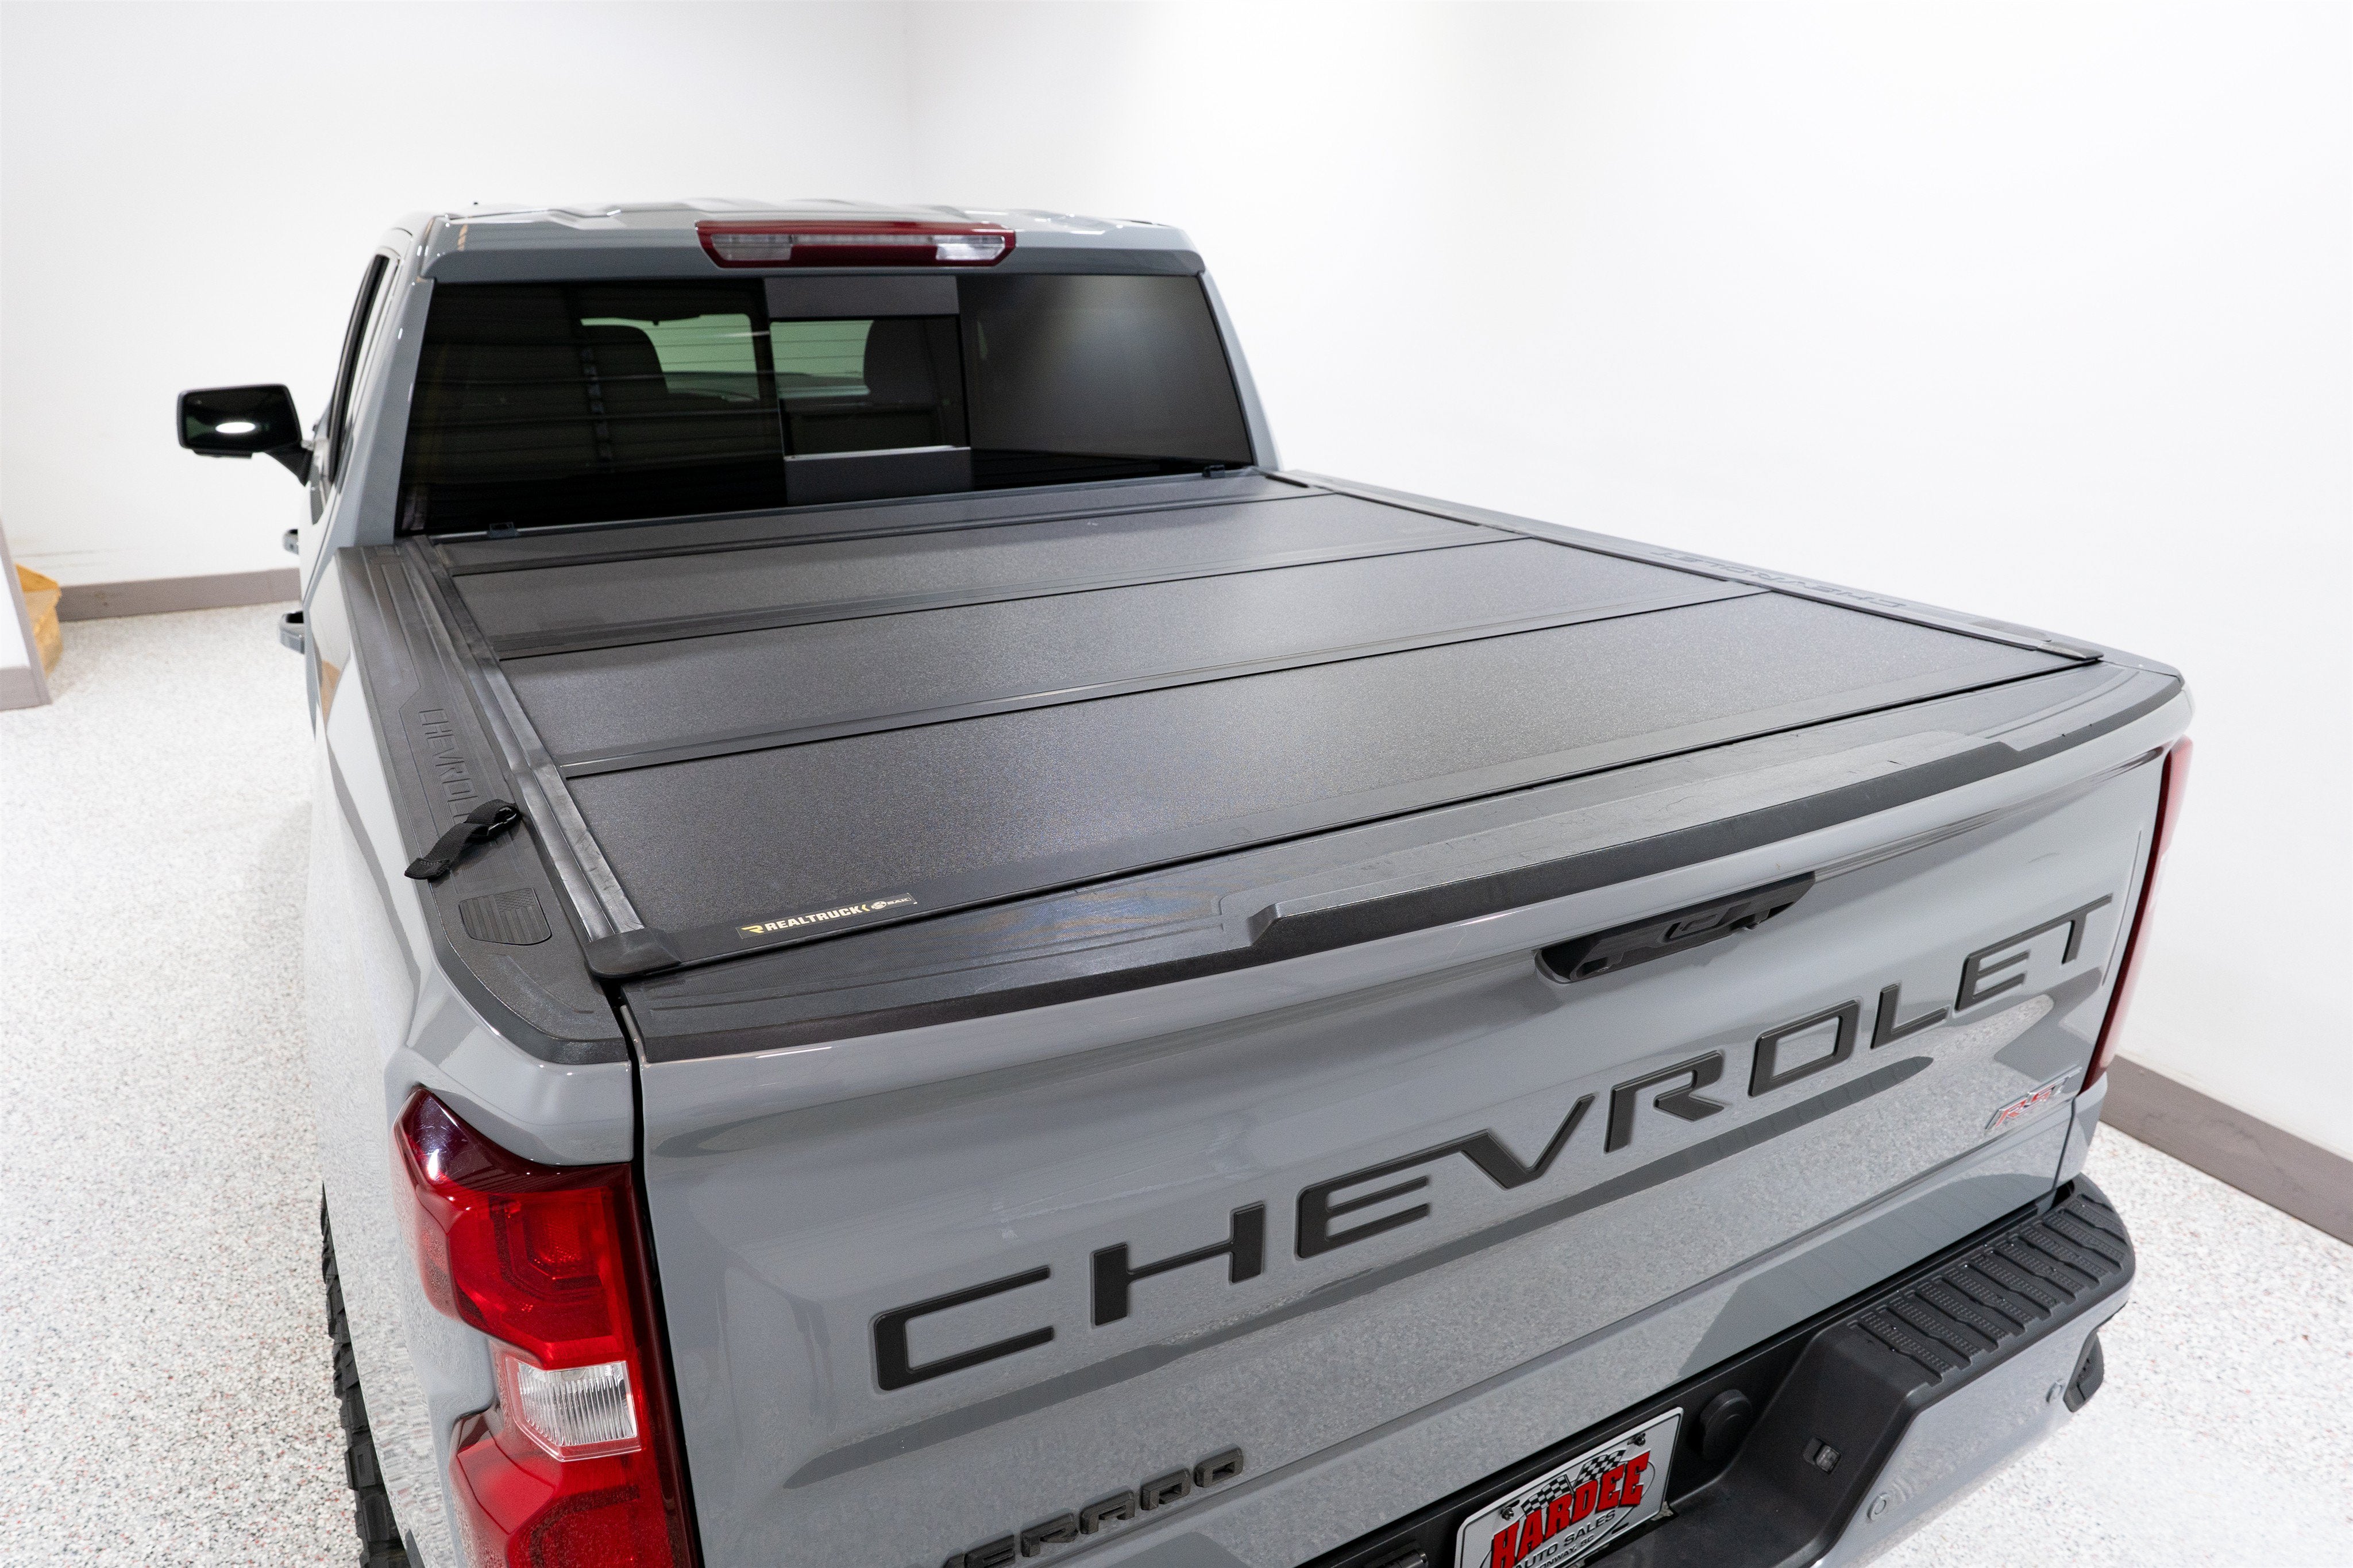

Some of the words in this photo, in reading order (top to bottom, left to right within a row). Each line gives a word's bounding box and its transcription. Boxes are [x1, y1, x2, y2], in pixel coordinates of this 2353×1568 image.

[419, 709, 480, 824] CHEVROL
[765, 905, 863, 931] REALTRUCK
[873, 893, 2113, 1391] CHEVROLET
[943, 1447, 1244, 1568] ERADO
[1491, 1451, 1650, 1568] HARDEE
[1564, 1509, 1616, 1546] SALES
[1580, 1535, 1595, 1547] SC
